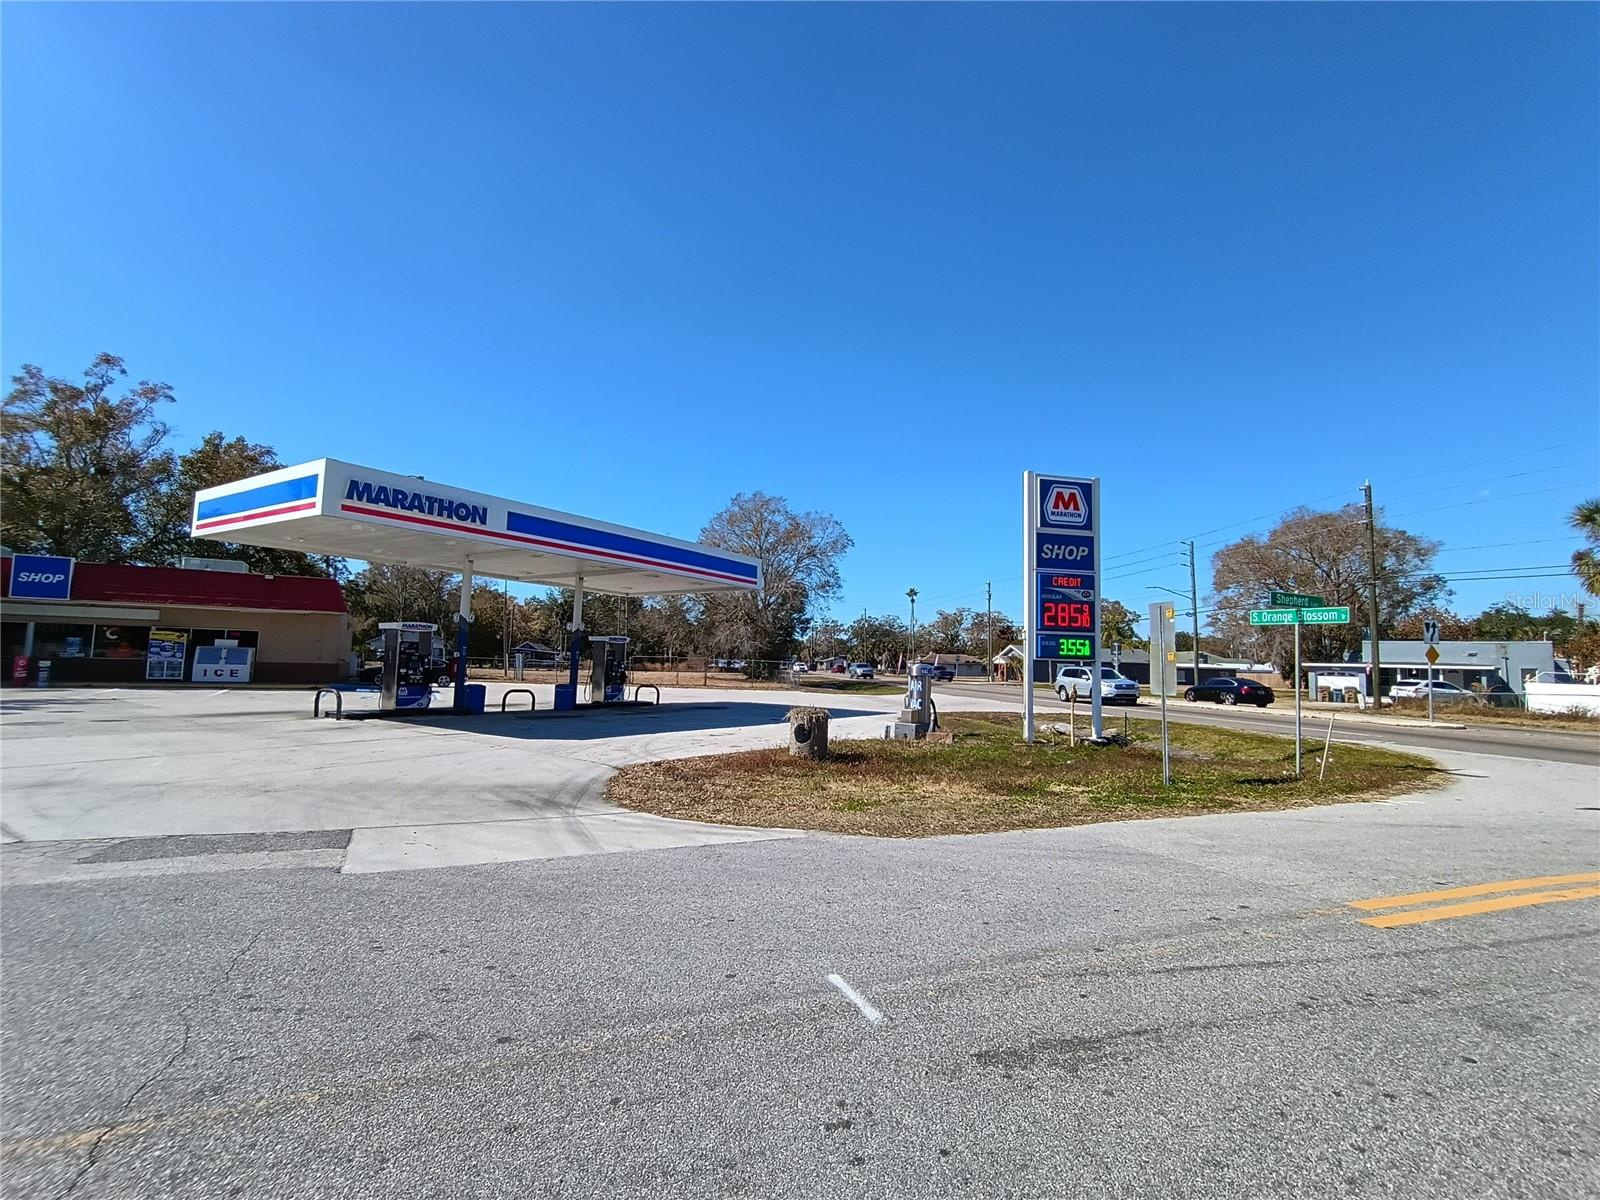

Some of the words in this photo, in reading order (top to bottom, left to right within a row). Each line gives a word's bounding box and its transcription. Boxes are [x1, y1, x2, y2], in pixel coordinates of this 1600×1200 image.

[346, 480, 488, 525] MARATHON
[1052, 491, 1080, 511] M
[1050, 511, 1082, 519] MARATHON
[1041, 544, 1089, 560] SHOP
[18, 572, 65, 583] SHOP
[1052, 577, 1082, 587] CREDIT
[1276, 593, 1309, 607] Shepherd
[1262, 612, 1293, 624] Orange
[1297, 611, 1338, 621] Blossom
[203, 668, 240, 678] ICE
[910, 680, 923, 692] AIR
